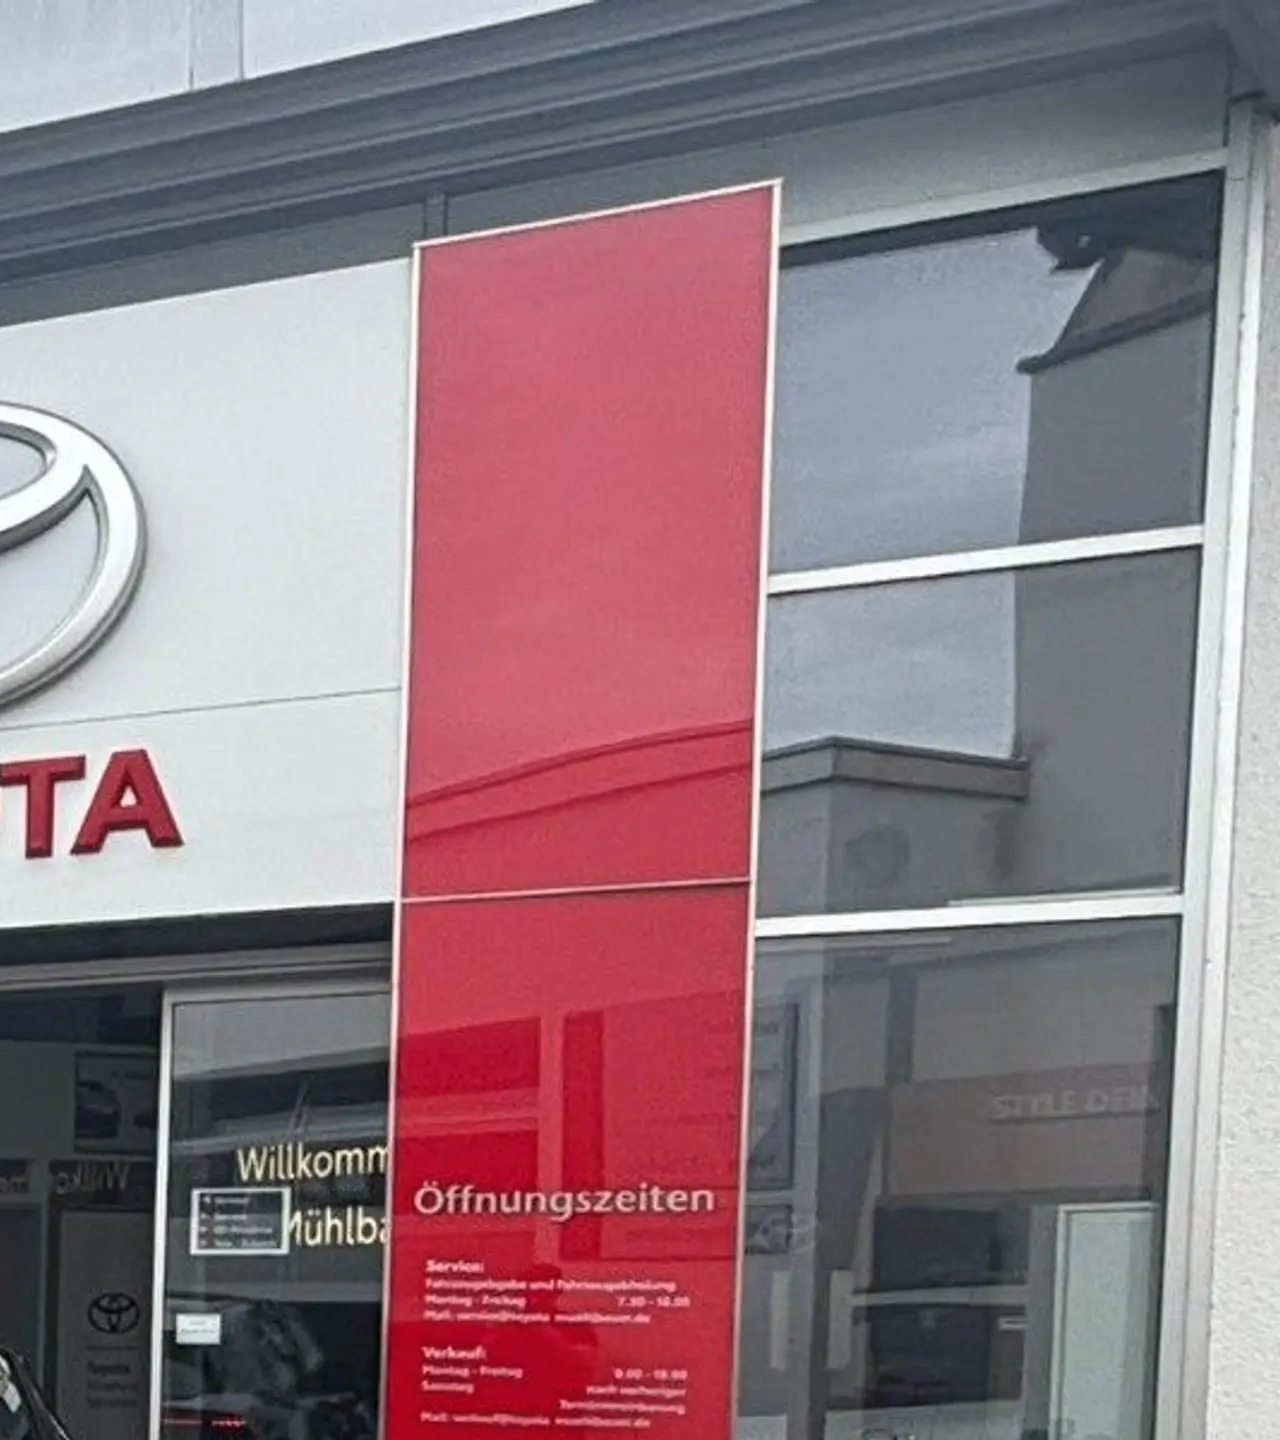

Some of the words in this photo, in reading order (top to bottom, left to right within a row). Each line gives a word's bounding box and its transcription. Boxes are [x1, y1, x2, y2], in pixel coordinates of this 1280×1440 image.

[237, 1142, 389, 1182] Willkomm
[414, 1180, 715, 1221] Öffnungszeiten
[421, 1346, 486, 1360] Verkauf:
